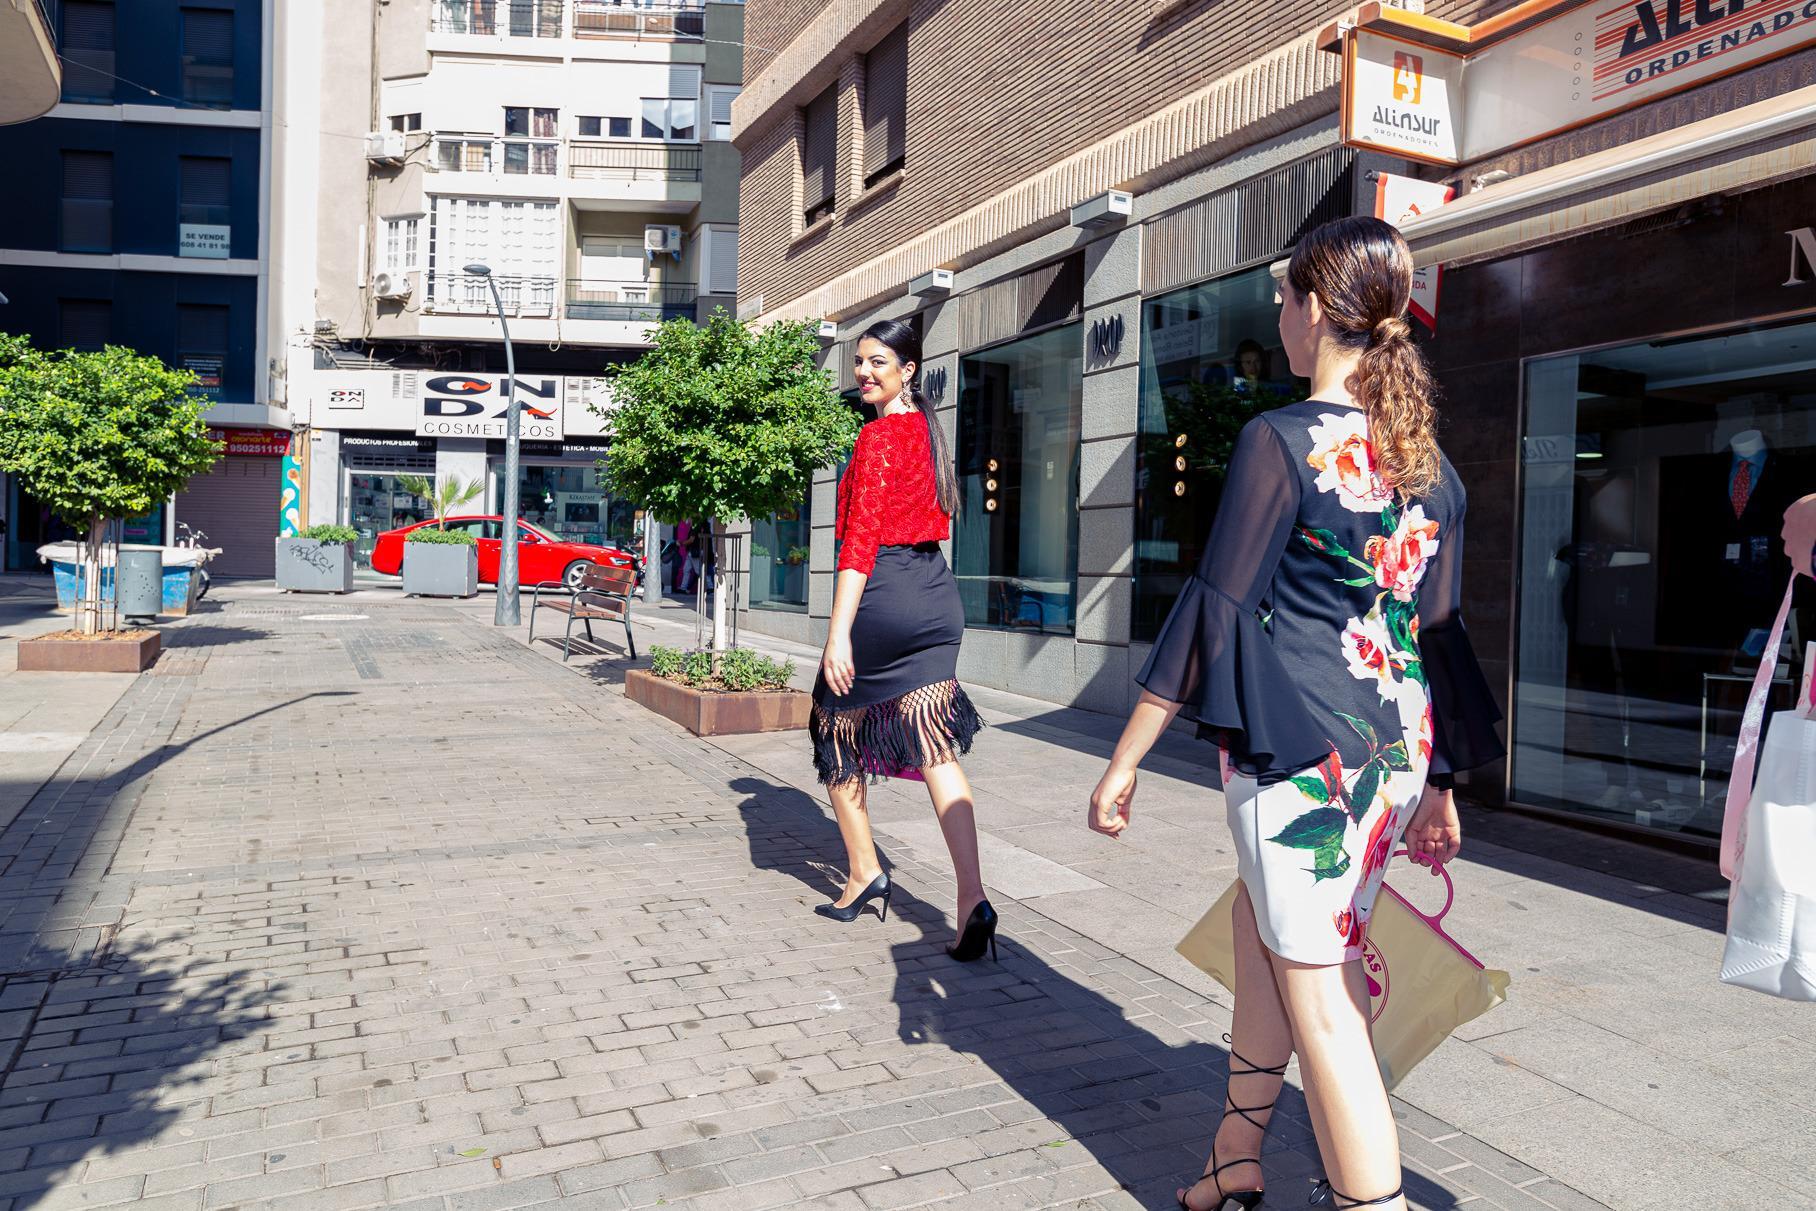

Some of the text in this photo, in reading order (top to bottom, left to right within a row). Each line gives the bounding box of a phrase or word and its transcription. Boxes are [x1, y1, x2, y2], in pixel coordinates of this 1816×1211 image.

[198, 233, 225, 241] VENDE
[424, 422, 555, 437] COSMETCOS
[230, 444, 285, 453] 950251112
